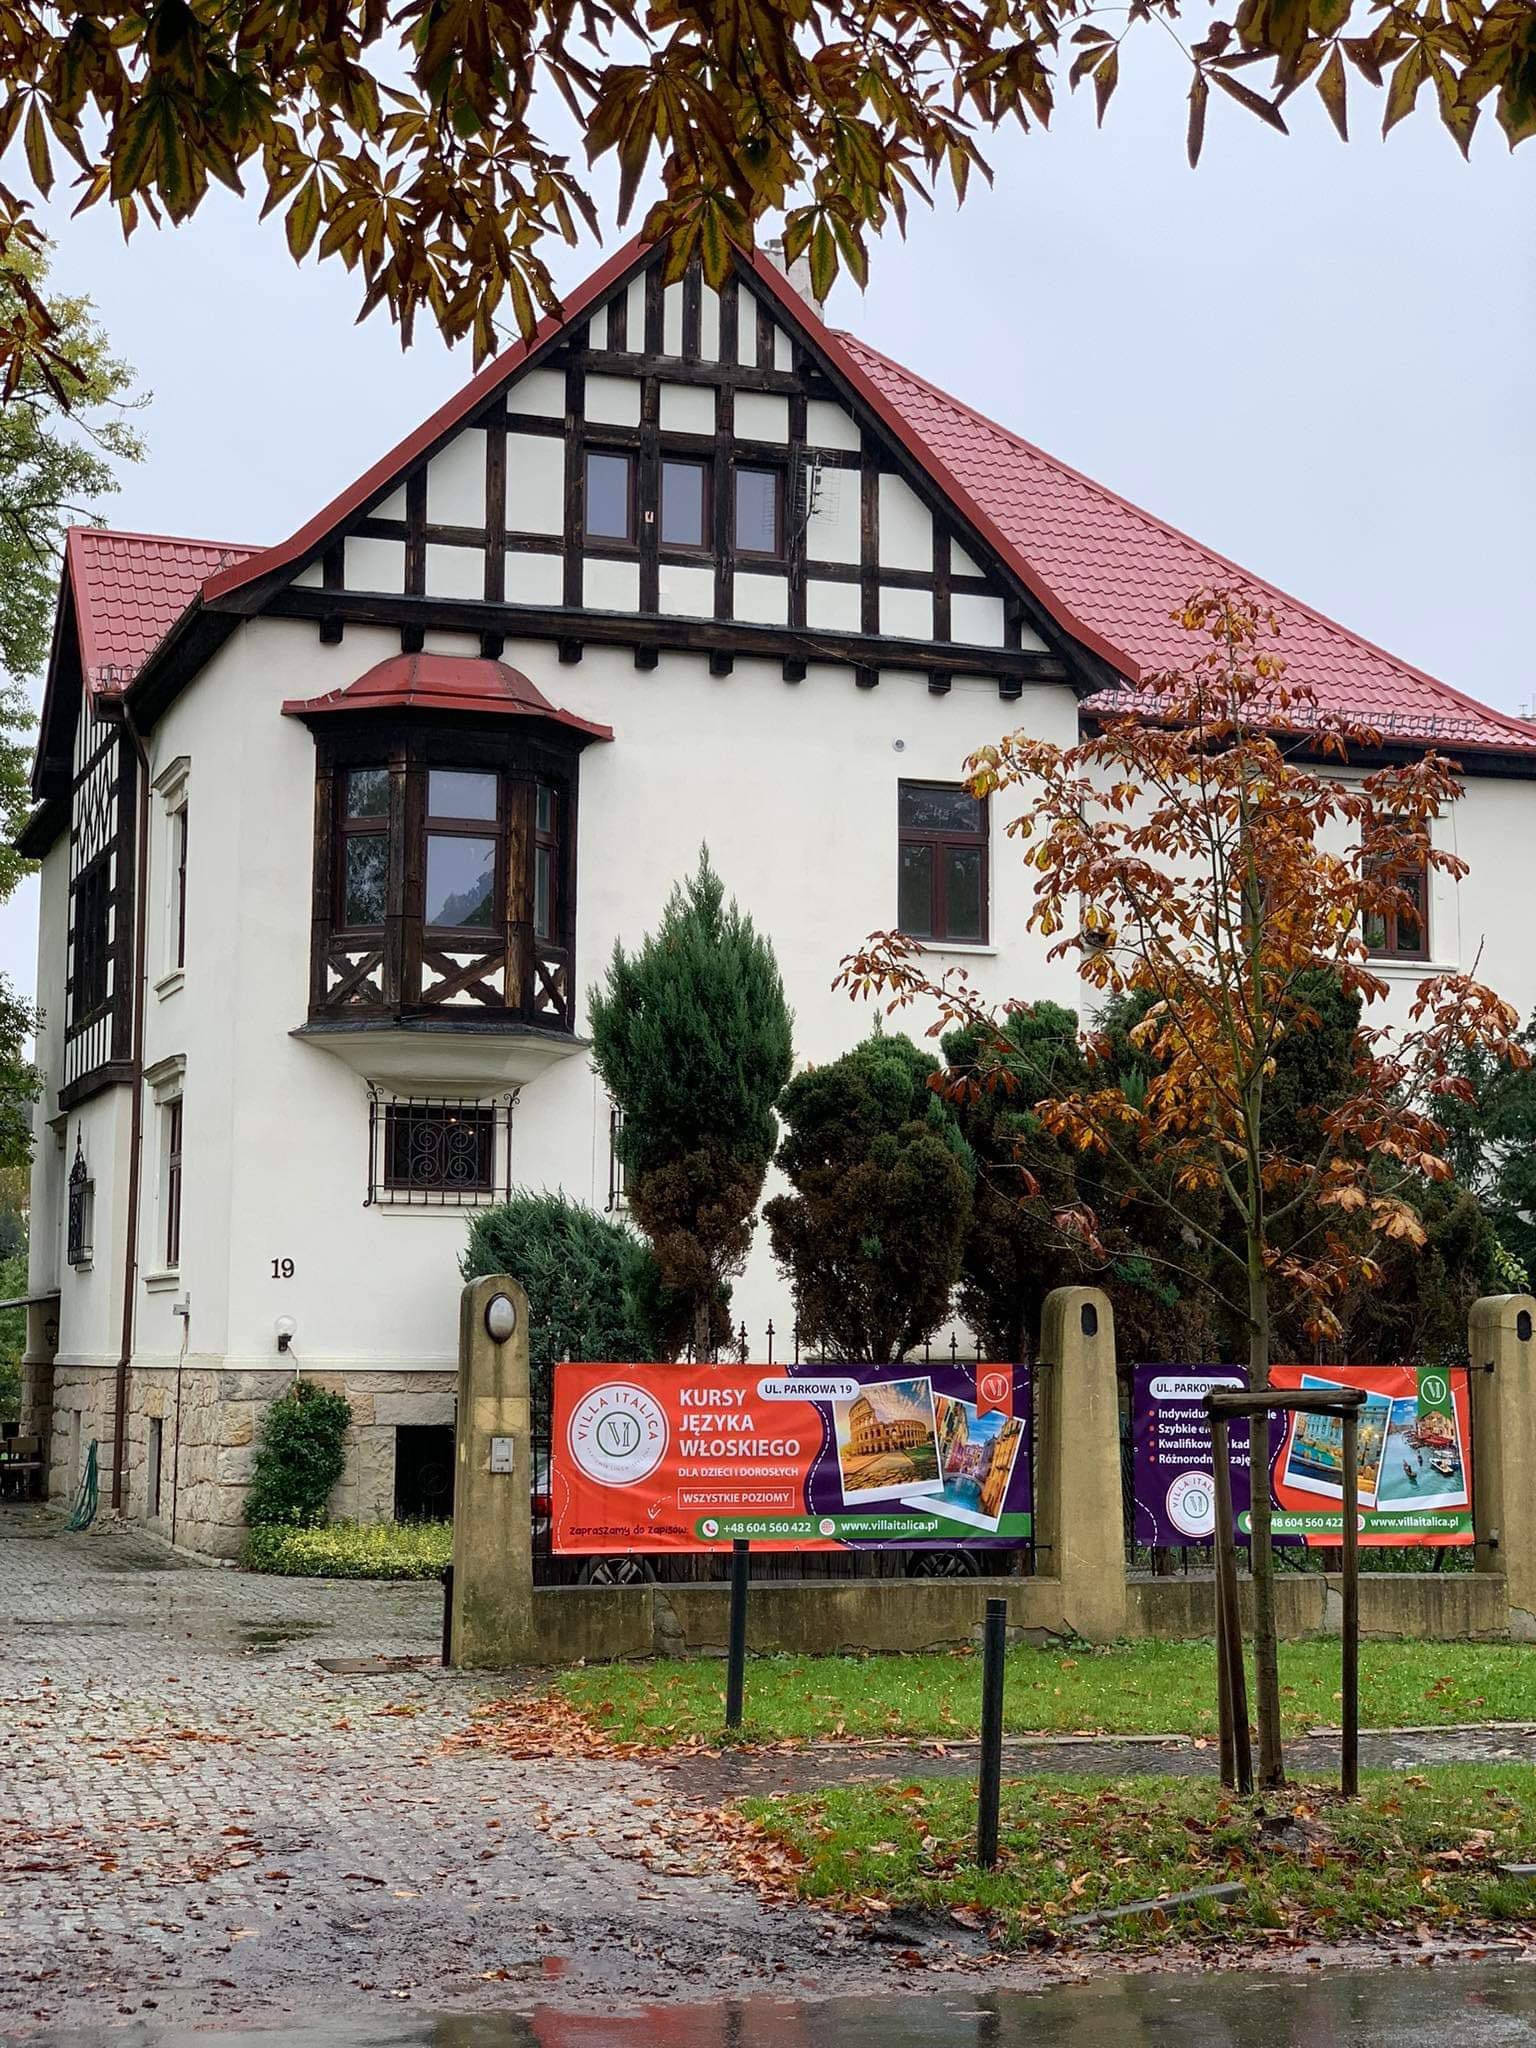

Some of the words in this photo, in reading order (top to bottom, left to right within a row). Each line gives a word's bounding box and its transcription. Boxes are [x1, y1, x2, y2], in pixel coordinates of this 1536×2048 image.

[271, 1258, 295, 1279] 19
[765, 1384, 782, 1394] UL.
[784, 1384, 837, 1394] PARKOWA
[840, 1384, 853, 1394] 19
[1156, 1384, 1172, 1393] UL.
[679, 1389, 747, 1406] KURSY
[577, 1397, 609, 1441] VILLA
[615, 1392, 659, 1441] ITALICA
[678, 1414, 755, 1436] JĘZYKA
[1158, 1423, 1198, 1436] Szybkie
[679, 1439, 801, 1457] WŁOSKIEGO
[678, 1468, 699, 1477] DLA
[701, 1467, 733, 1477] DZIECI
[740, 1467, 799, 1477] DOROSŁYCH
[682, 1493, 740, 1503] WSZYSTKIE
[742, 1493, 790, 1502] POZIOMY
[723, 1523, 744, 1533] +48
[746, 1523, 767, 1533] 604
[769, 1522, 789, 1532] 560
[791, 1522, 812, 1532] 422
[841, 1519, 938, 1532] www.villaitalica.pl
[1284, 1517, 1303, 1527] 604
[1305, 1517, 1324, 1527] 560
[1325, 1517, 1344, 1527] 422
[1370, 1516, 1459, 1529] www.villaitalica.pl
